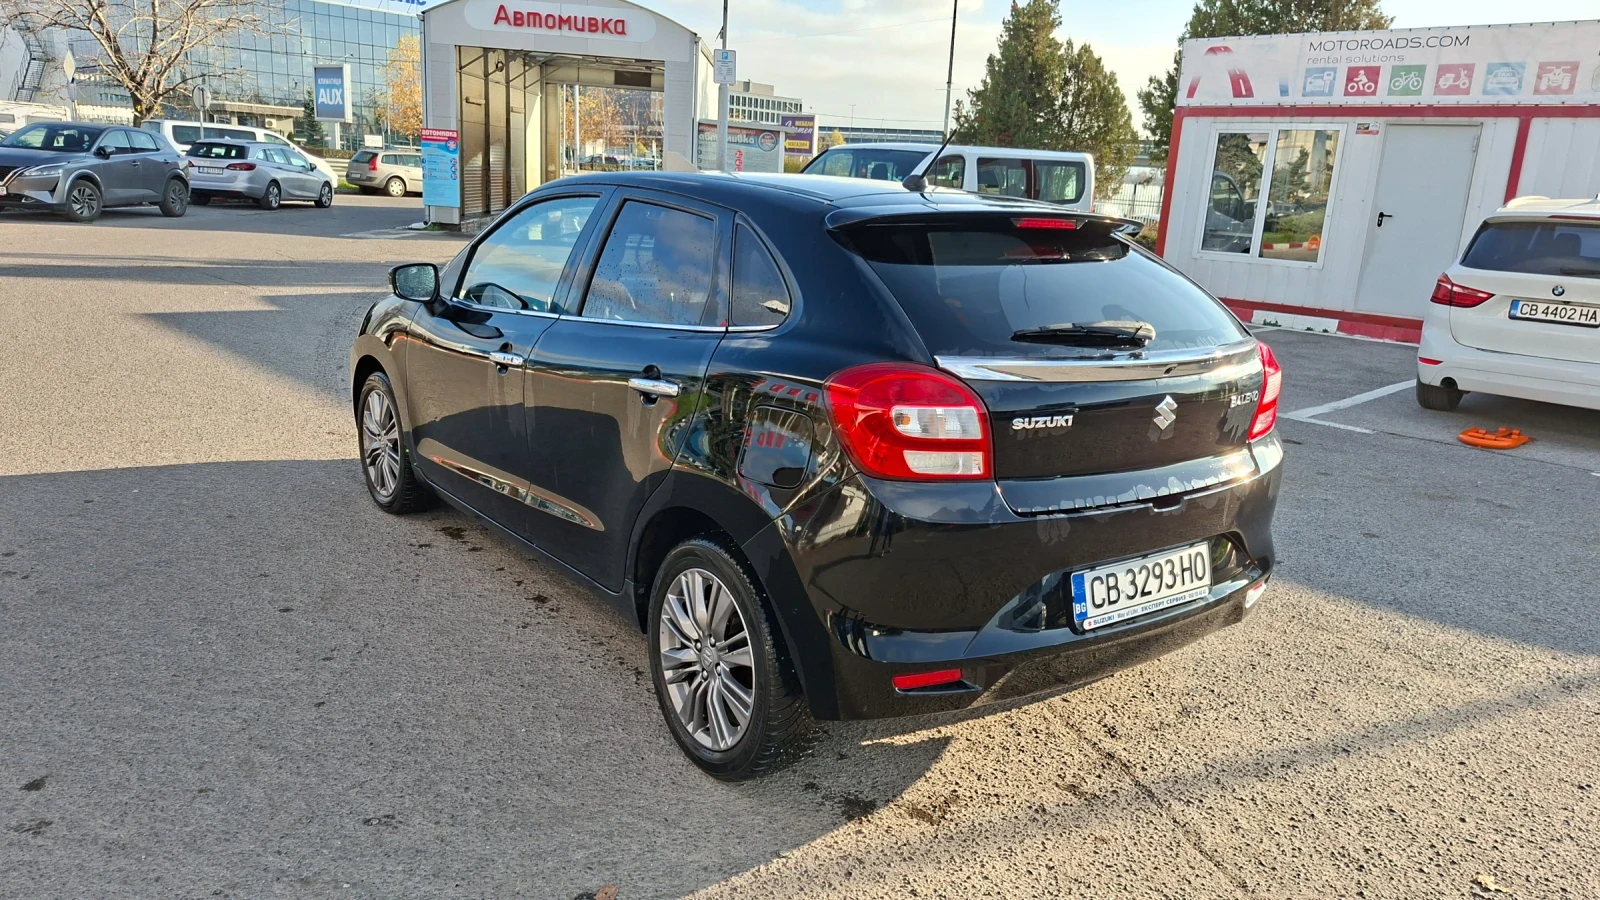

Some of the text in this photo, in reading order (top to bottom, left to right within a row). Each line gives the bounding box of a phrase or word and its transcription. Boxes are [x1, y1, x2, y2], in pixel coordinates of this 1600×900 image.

[493, 4, 627, 36] Автомивка
[1308, 35, 1470, 52] MOTOROADS.COM
[1306, 53, 1405, 65] rental solutions
[318, 88, 344, 105] AUX
[1519, 302, 1539, 316] CB
[1541, 305, 1577, 321] 4402
[1578, 309, 1598, 323] HA
[1230, 390, 1259, 408] BALENO
[1012, 414, 1074, 430] SUZUKI
[1090, 551, 1207, 609] CB 3293 HO
[1075, 602, 1087, 615] BG
[1093, 615, 1115, 626] SUZUKI
[1141, 600, 1165, 612] ЕКСПЕРТ
[1166, 594, 1187, 605] СЕРВИЗ
